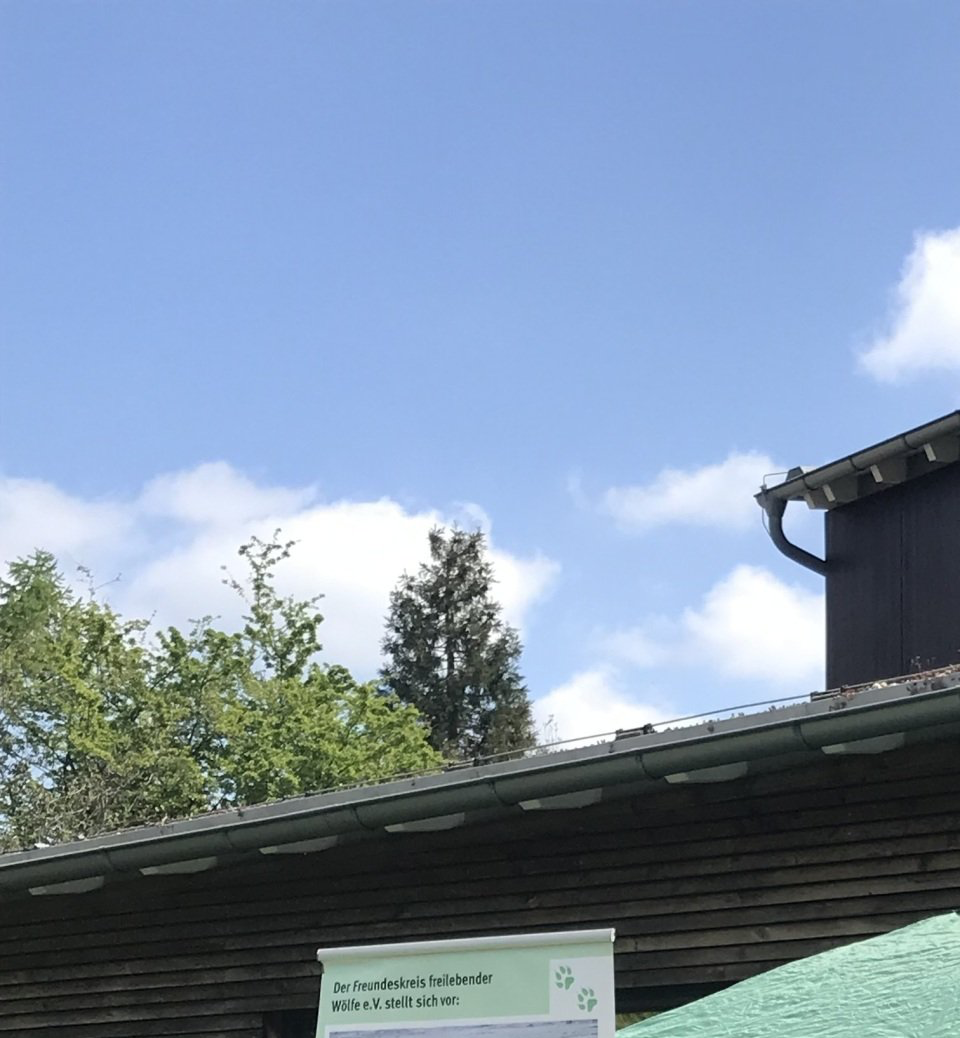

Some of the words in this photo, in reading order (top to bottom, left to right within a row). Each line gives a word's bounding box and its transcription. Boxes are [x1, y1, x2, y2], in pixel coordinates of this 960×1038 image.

[333, 982, 350, 993] Der
[353, 976, 426, 992] Freundeskreis
[429, 972, 493, 987] freilebender
[332, 999, 360, 1012] Wölfe
[363, 998, 382, 1011] e.V.
[385, 996, 413, 1009] stellt
[416, 995, 437, 1007] sich
[441, 997, 459, 1006] vor:
